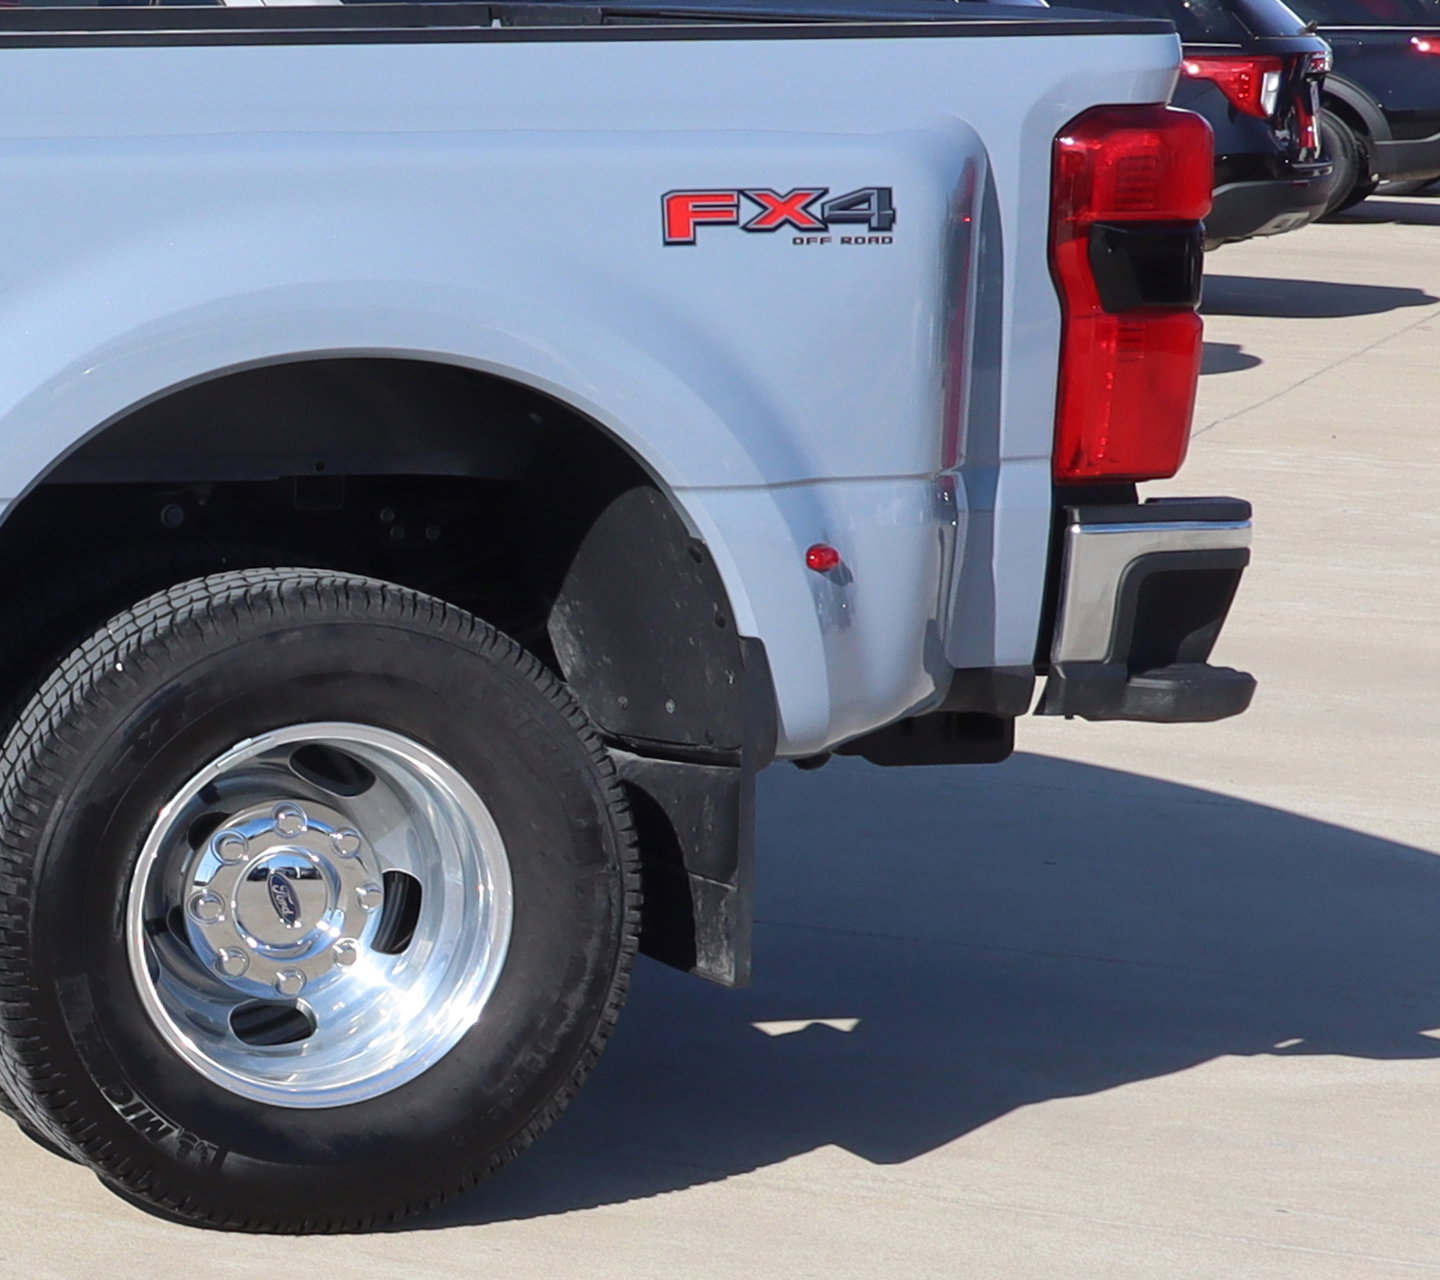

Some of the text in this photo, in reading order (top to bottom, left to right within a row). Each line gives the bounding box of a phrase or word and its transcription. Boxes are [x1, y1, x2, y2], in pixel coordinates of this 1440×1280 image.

[661, 187, 897, 247] FX4
[792, 235, 894, 246] OFF ROAD
